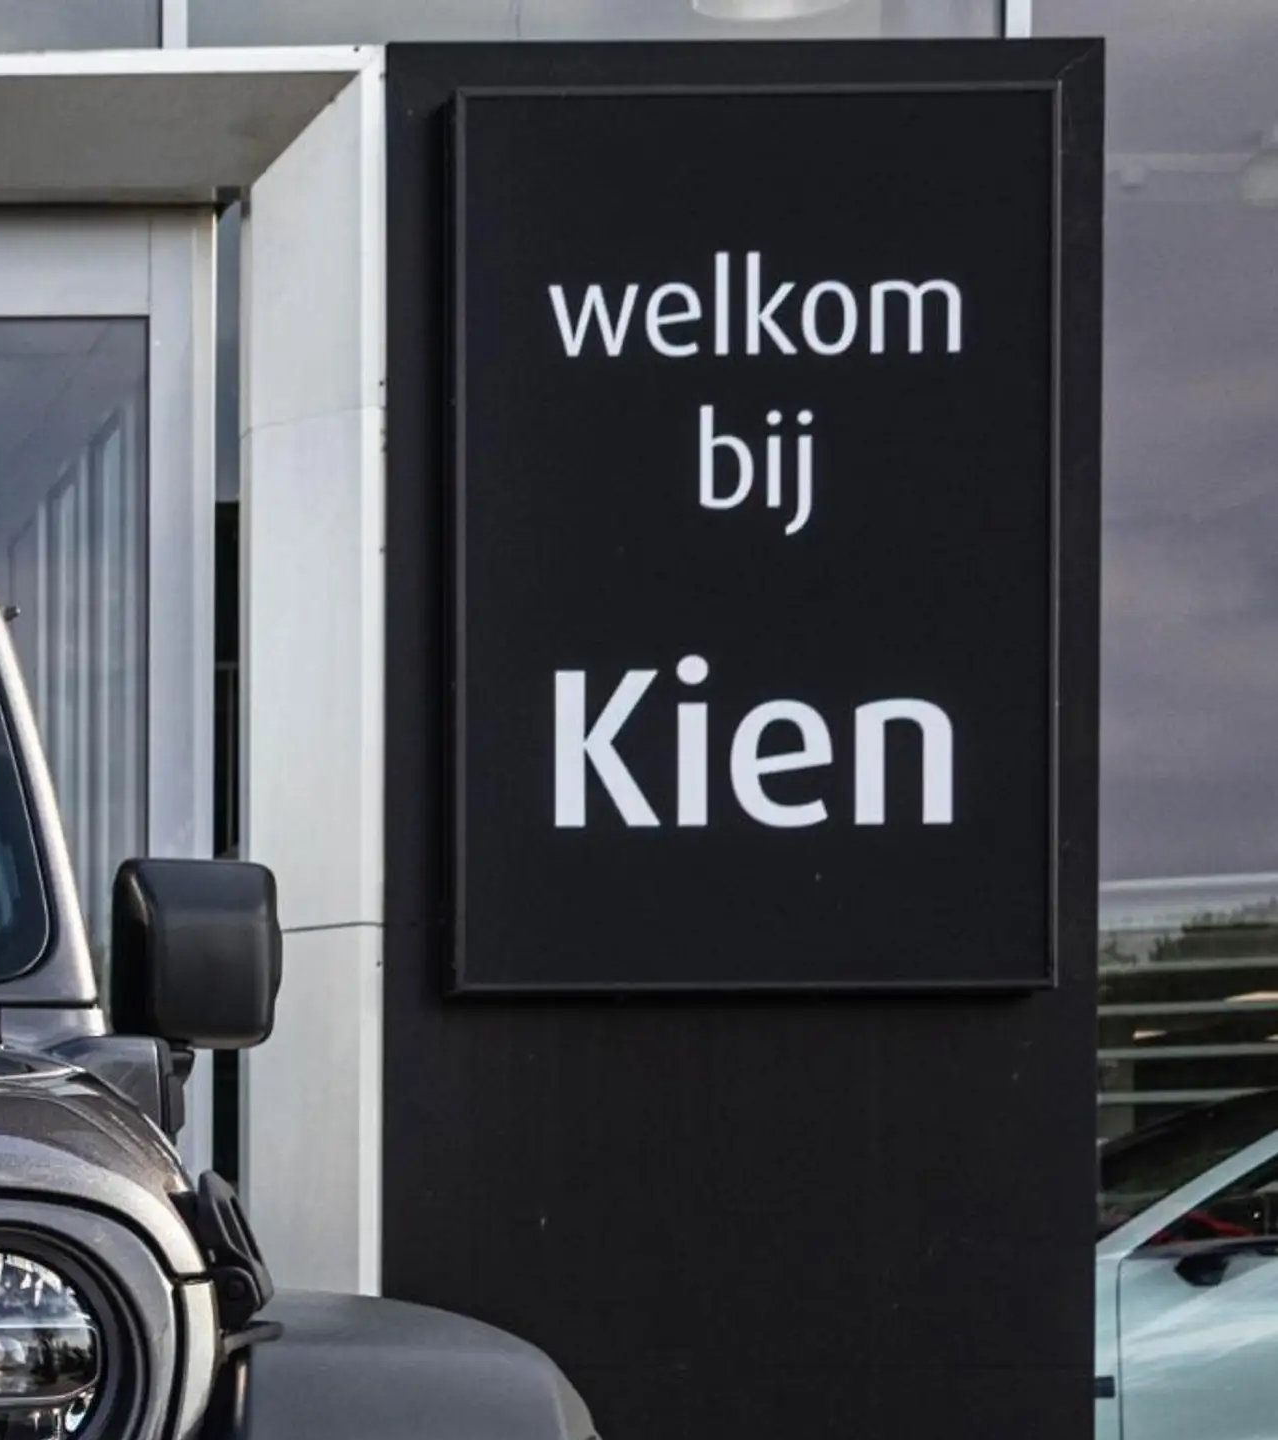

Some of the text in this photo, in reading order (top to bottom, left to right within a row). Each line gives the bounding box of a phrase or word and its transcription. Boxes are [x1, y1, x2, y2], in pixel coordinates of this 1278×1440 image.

[548, 251, 963, 357] welkom
[699, 404, 814, 536] bij
[554, 654, 954, 828] Kien
